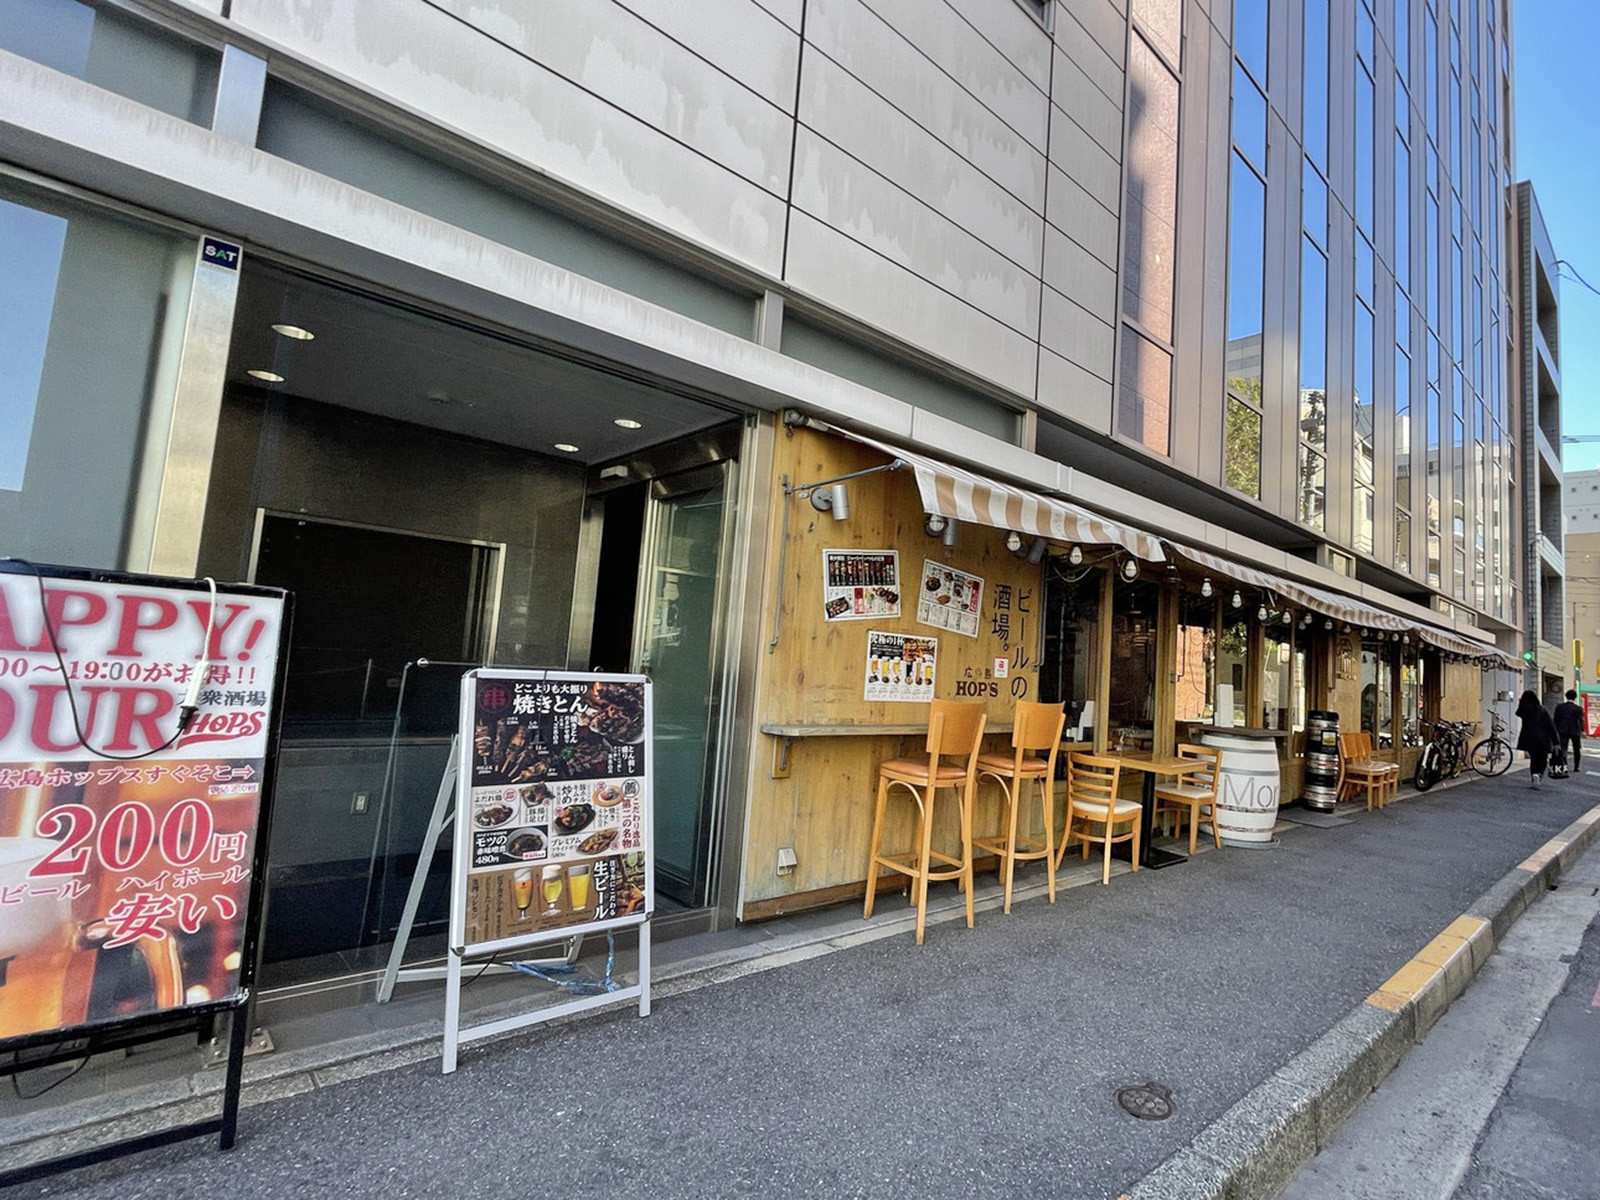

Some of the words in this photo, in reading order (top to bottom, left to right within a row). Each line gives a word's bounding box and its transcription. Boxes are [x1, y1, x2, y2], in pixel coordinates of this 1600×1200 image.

[205, 245, 238, 262] SAT
[1011, 587, 1033, 699] ビールの
[514, 683, 588, 694] どこよりも大振り
[512, 694, 588, 714] 焼きとん
[0, 684, 174, 753] UR
[180, 710, 267, 738] HOPS
[562, 785, 572, 804] 炒め
[622, 799, 632, 849] 第二の名物
[27, 798, 249, 880] 200円
[475, 835, 508, 847] モツの
[475, 854, 500, 864] 480円
[0, 879, 91, 905] ビール
[116, 865, 250, 892] ハイボール
[594, 860, 609, 920] 生ビール
[102, 892, 238, 949] 安い
